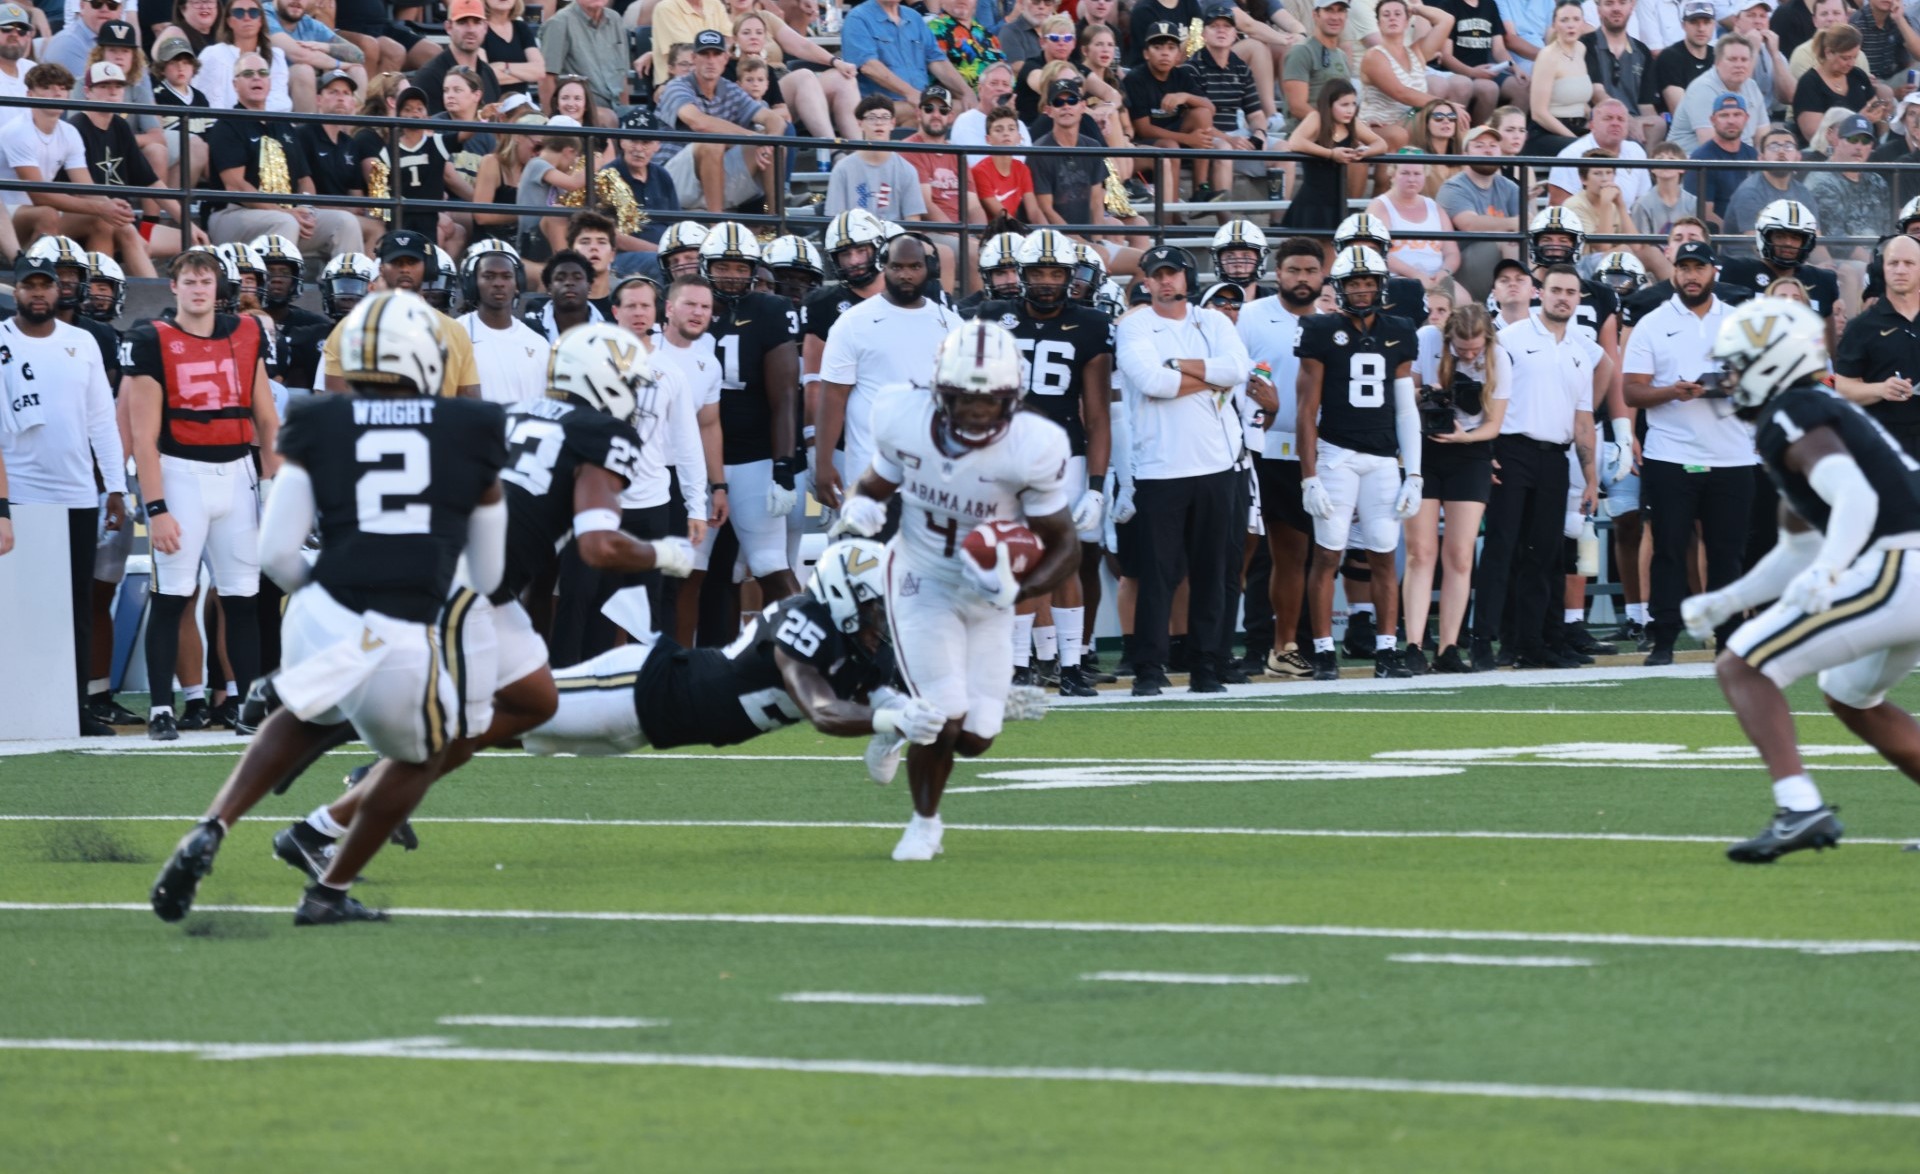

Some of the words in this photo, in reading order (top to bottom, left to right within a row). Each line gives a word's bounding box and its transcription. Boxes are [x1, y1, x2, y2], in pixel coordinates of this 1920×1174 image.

[109, 25, 129, 39] V
[1158, 23, 1170, 34] V
[408, 165, 421, 187] 1
[1741, 315, 1777, 348] V
[602, 338, 638, 371] V
[176, 358, 242, 411] 51
[1349, 352, 1386, 408] 8
[352, 400, 436, 425] WRIGHT
[1772, 409, 1805, 443] 1
[355, 428, 432, 534] 2
[963, 499, 999, 519] A&M
[924, 510, 958, 558] 4
[846, 546, 880, 576] V
[776, 608, 827, 658] 25
